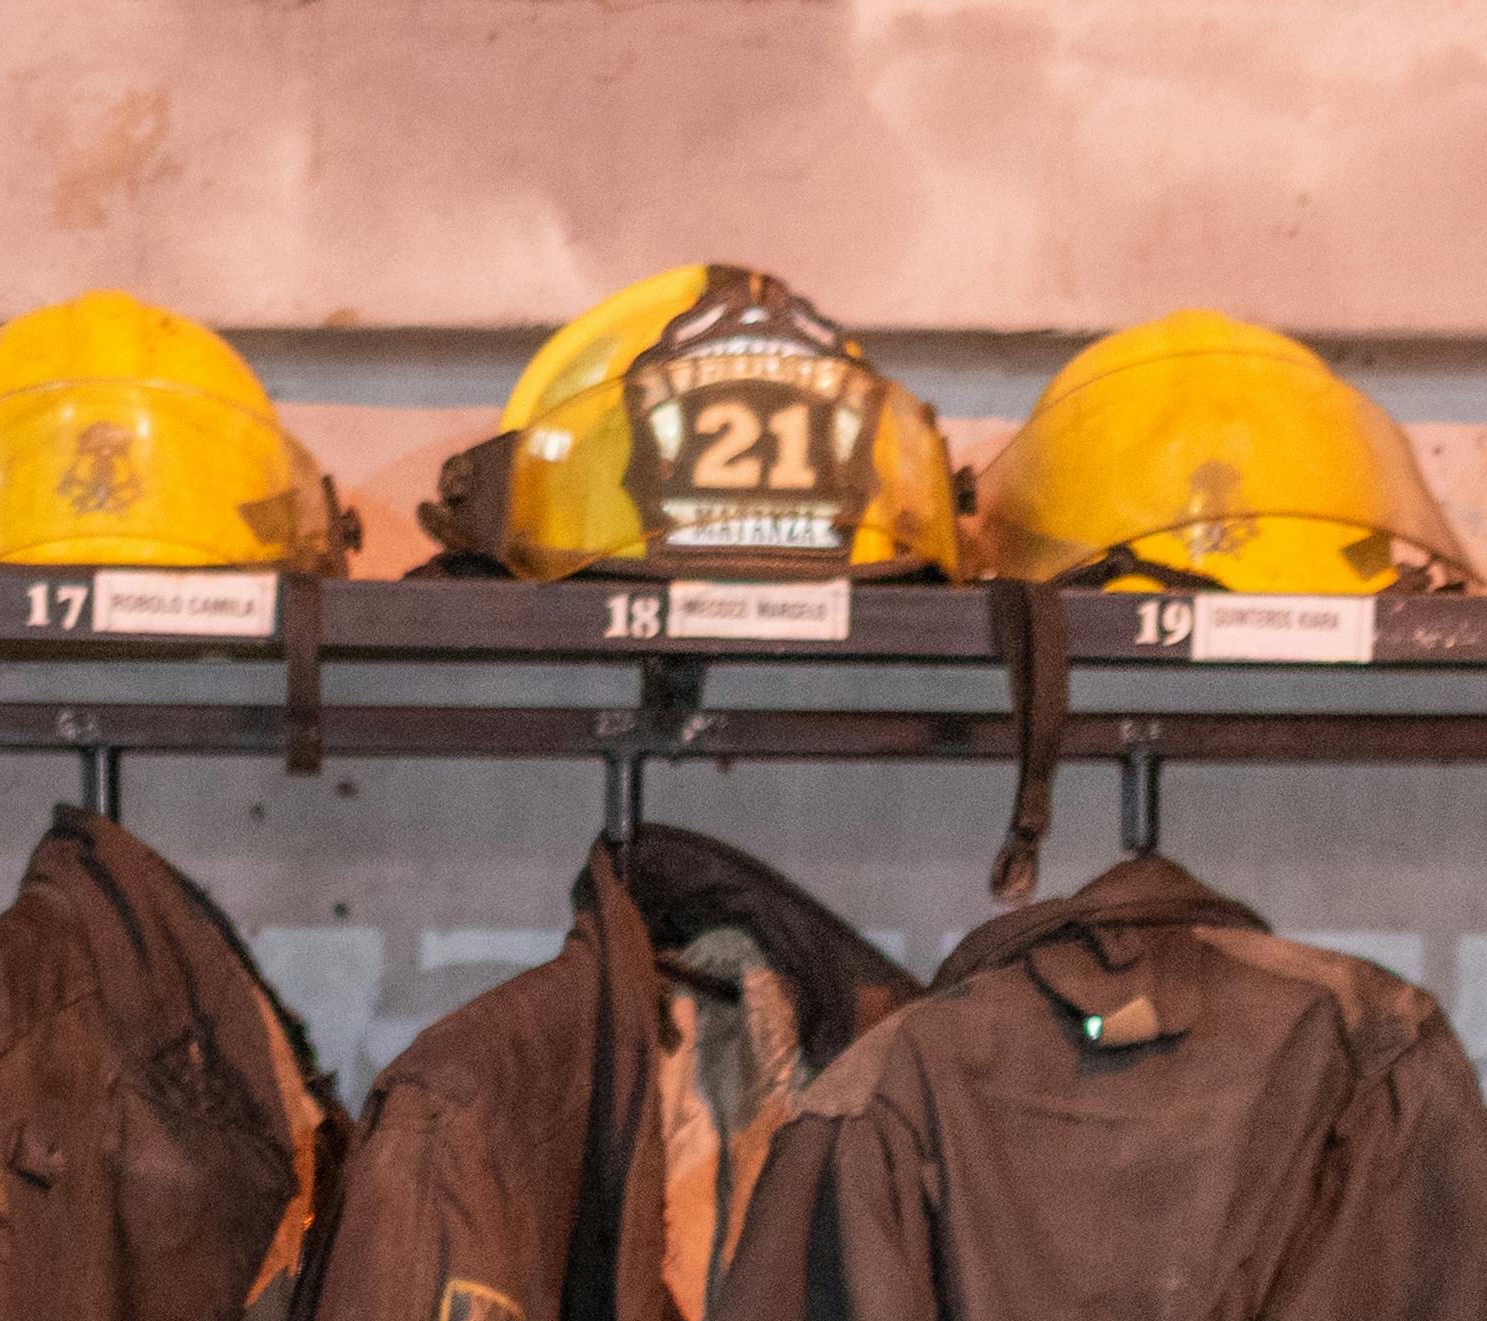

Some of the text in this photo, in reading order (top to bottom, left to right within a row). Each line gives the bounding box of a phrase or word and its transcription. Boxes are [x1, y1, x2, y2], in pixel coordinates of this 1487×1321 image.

[693, 400, 817, 490] 21
[26, 583, 88, 631] 17
[604, 594, 661, 639] 18
[1135, 601, 1194, 647] 19
